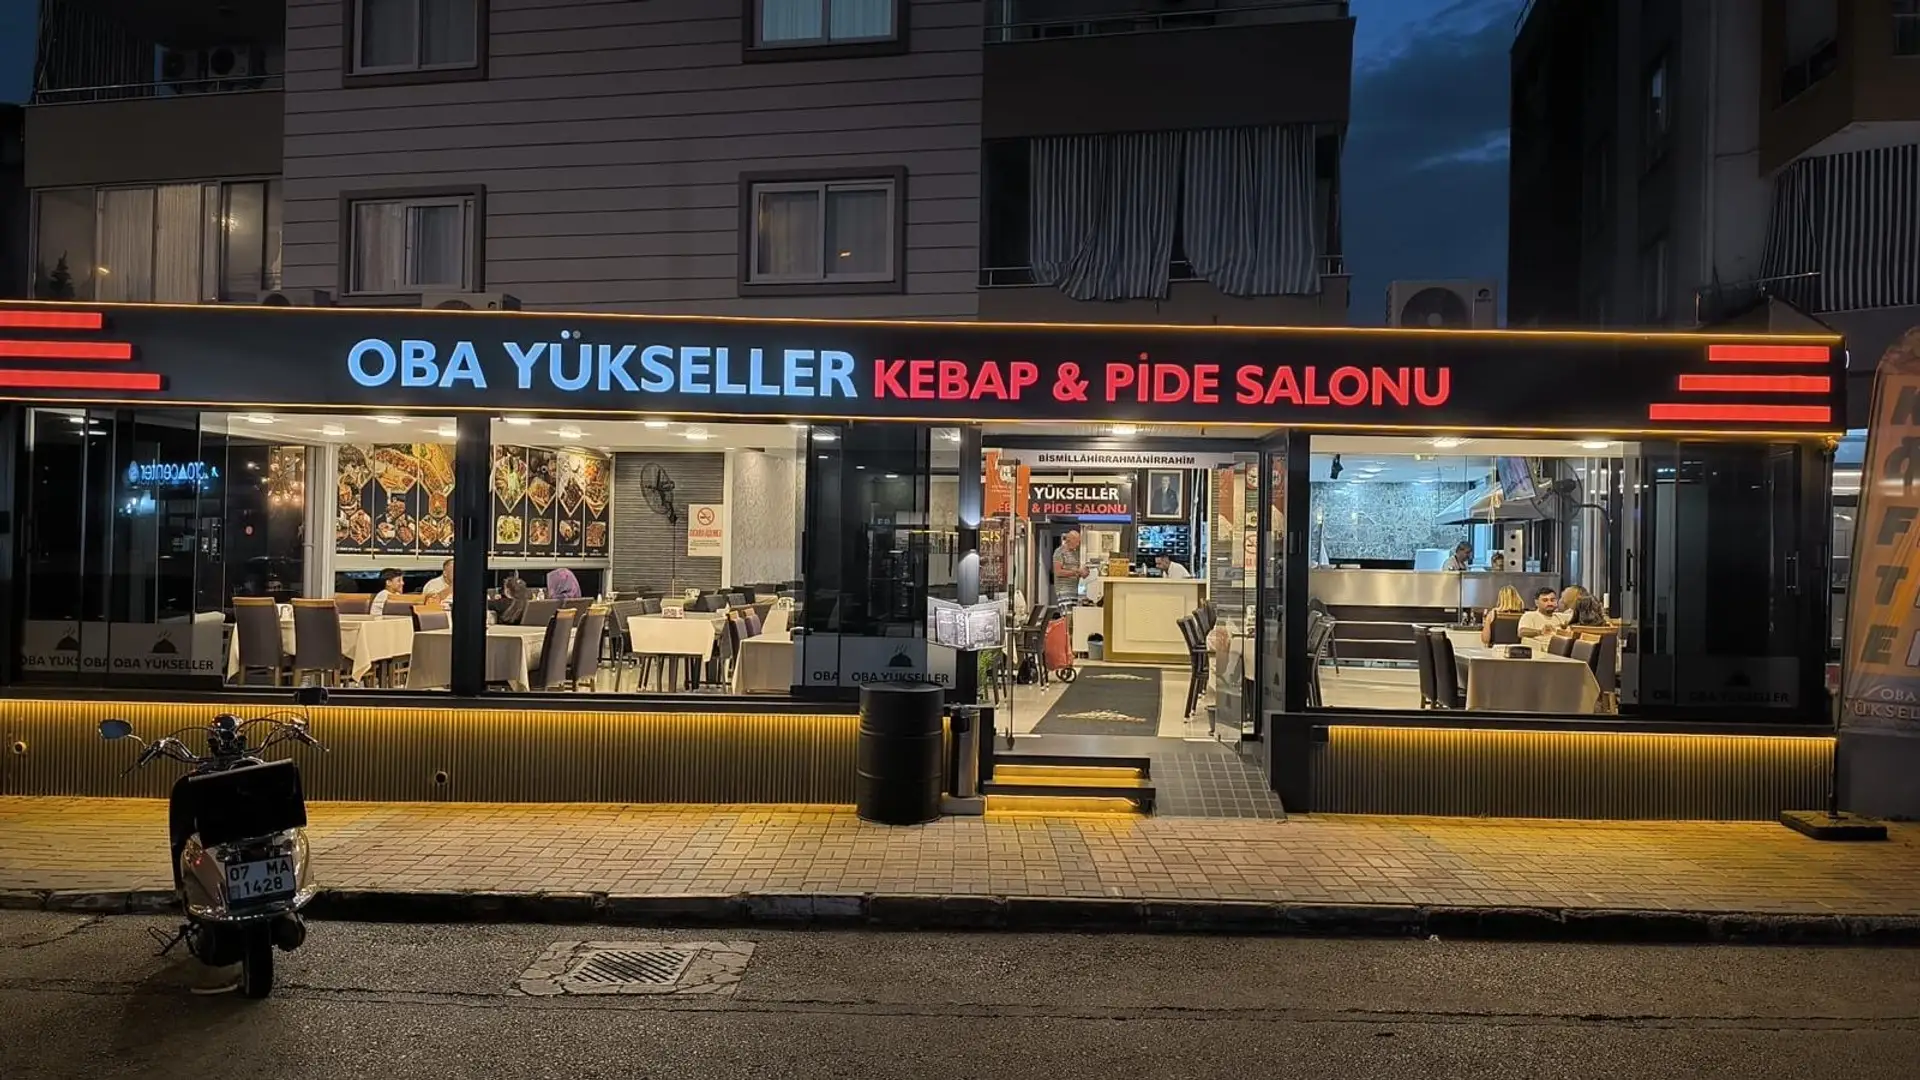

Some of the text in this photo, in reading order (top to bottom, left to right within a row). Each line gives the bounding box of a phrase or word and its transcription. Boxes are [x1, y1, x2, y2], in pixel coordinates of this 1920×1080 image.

[348, 330, 1451, 406] OBA YÜKSELLER KEBAP & PİDE SALONU
[1034, 485, 1119, 500] YÜKSELLER
[1043, 499, 1072, 514] PİDE
[1075, 502, 1127, 514] SALONU
[113, 657, 141, 668] OBA
[851, 671, 878, 682] OBA
[1880, 688, 1917, 702] OBA
[229, 860, 290, 881] 07 MA
[244, 876, 283, 895] 1428
